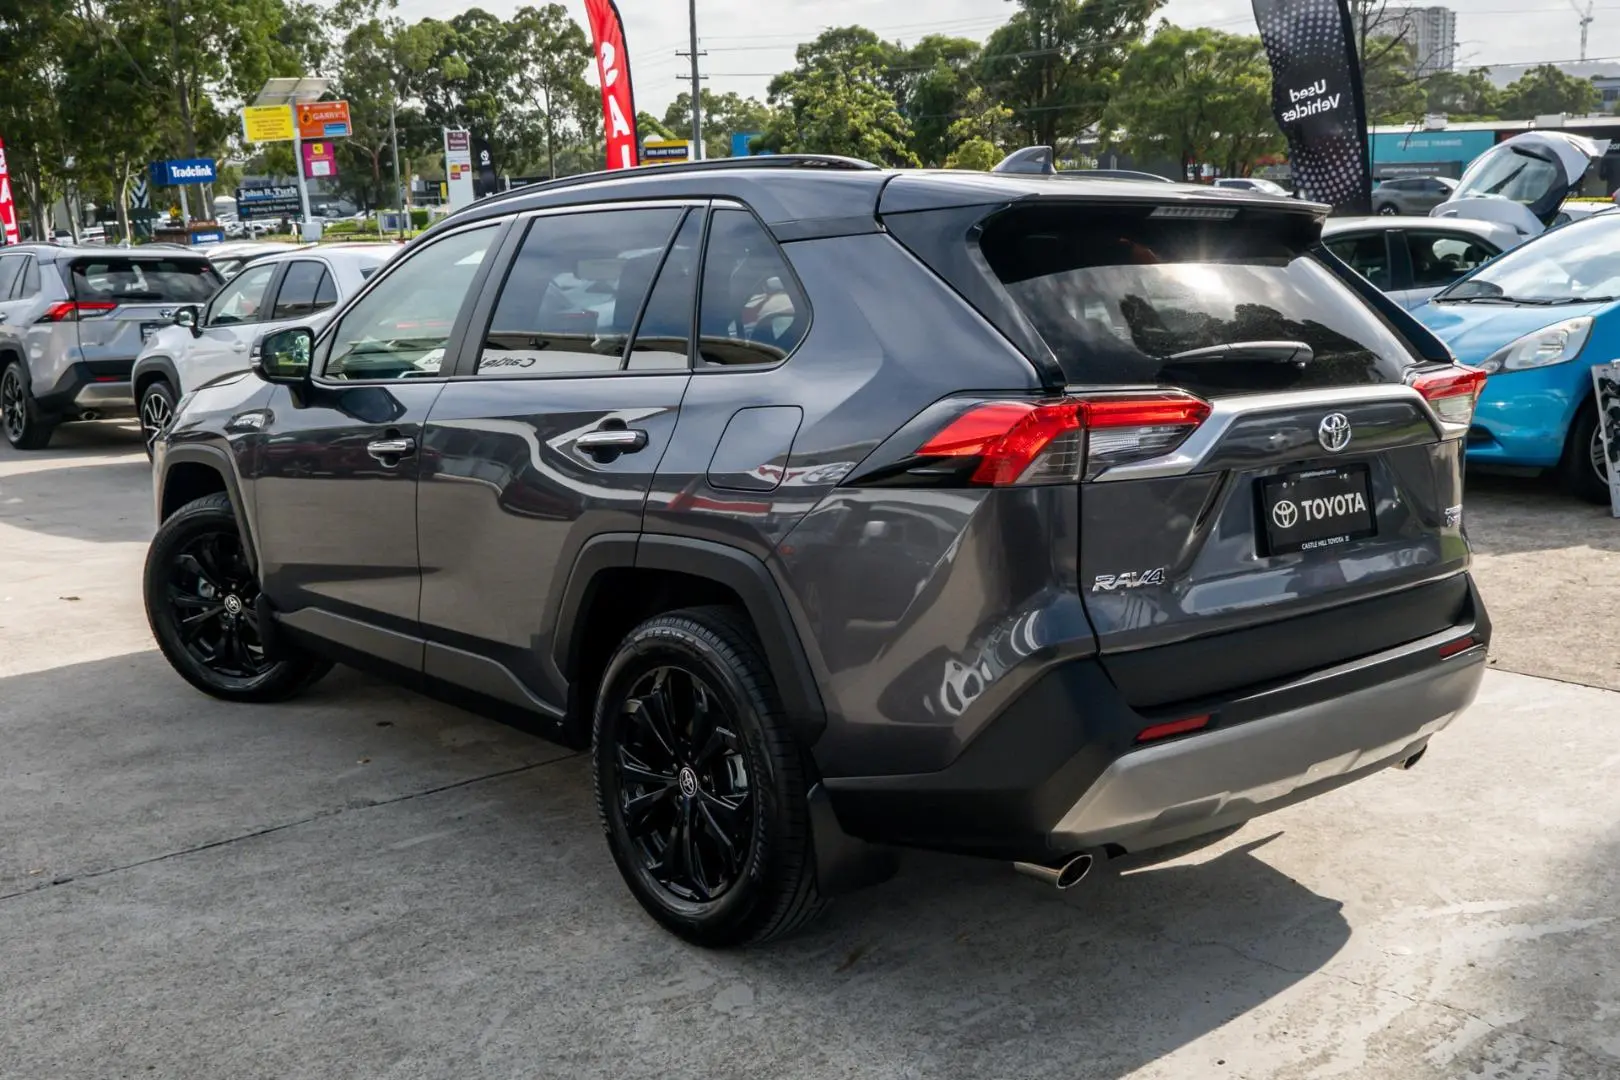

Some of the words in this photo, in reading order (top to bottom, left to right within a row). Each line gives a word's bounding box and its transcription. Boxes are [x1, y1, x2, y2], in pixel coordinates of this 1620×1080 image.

[170, 164, 213, 178] Tradelink
[1301, 492, 1366, 520] TOYOTA
[1301, 541, 1318, 550] CASTLE
[1318, 539, 1328, 547] HILL
[1327, 536, 1344, 545] TOYOTA
[1092, 567, 1166, 592] RAV4
